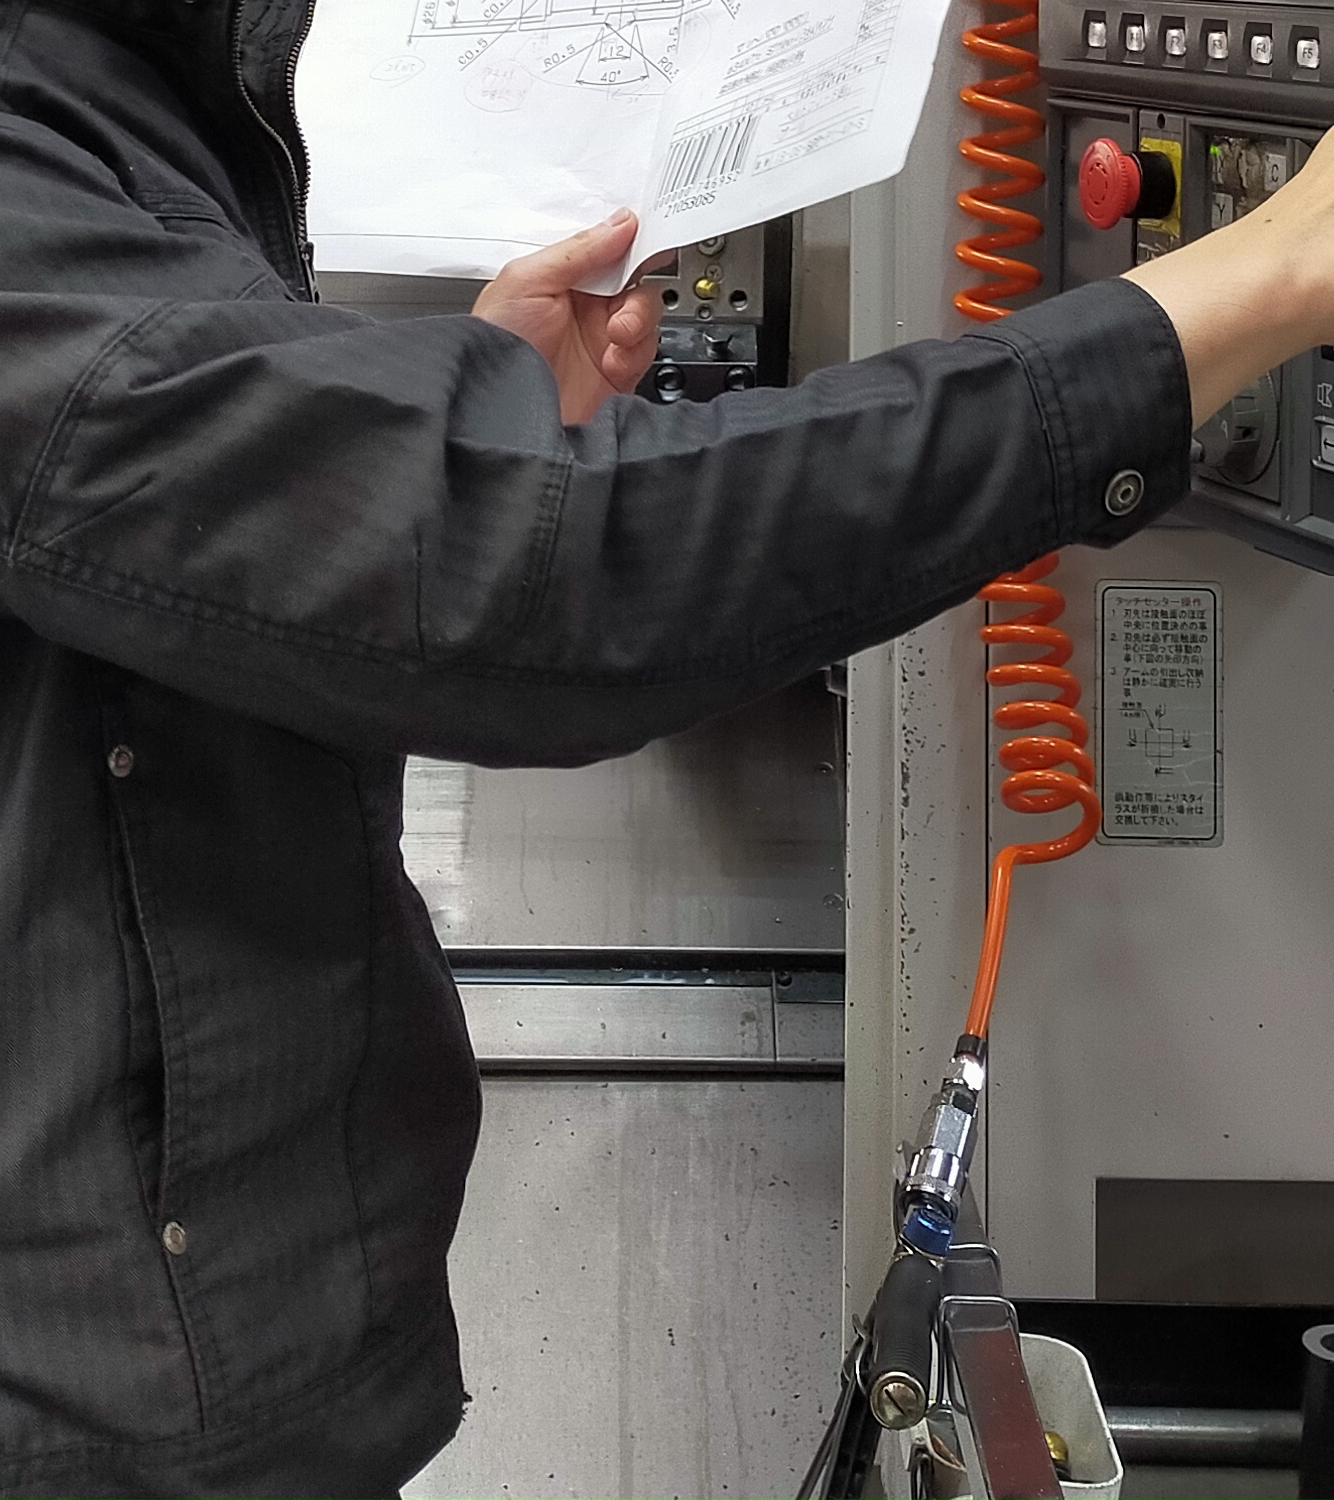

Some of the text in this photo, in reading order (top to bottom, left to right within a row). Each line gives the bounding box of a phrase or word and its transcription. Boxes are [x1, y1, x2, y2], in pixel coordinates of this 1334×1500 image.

[1256, 44, 1266, 54] F4
[1303, 48, 1313, 59] F5
[1271, 164, 1279, 182] C
[1215, 202, 1225, 220] Y
